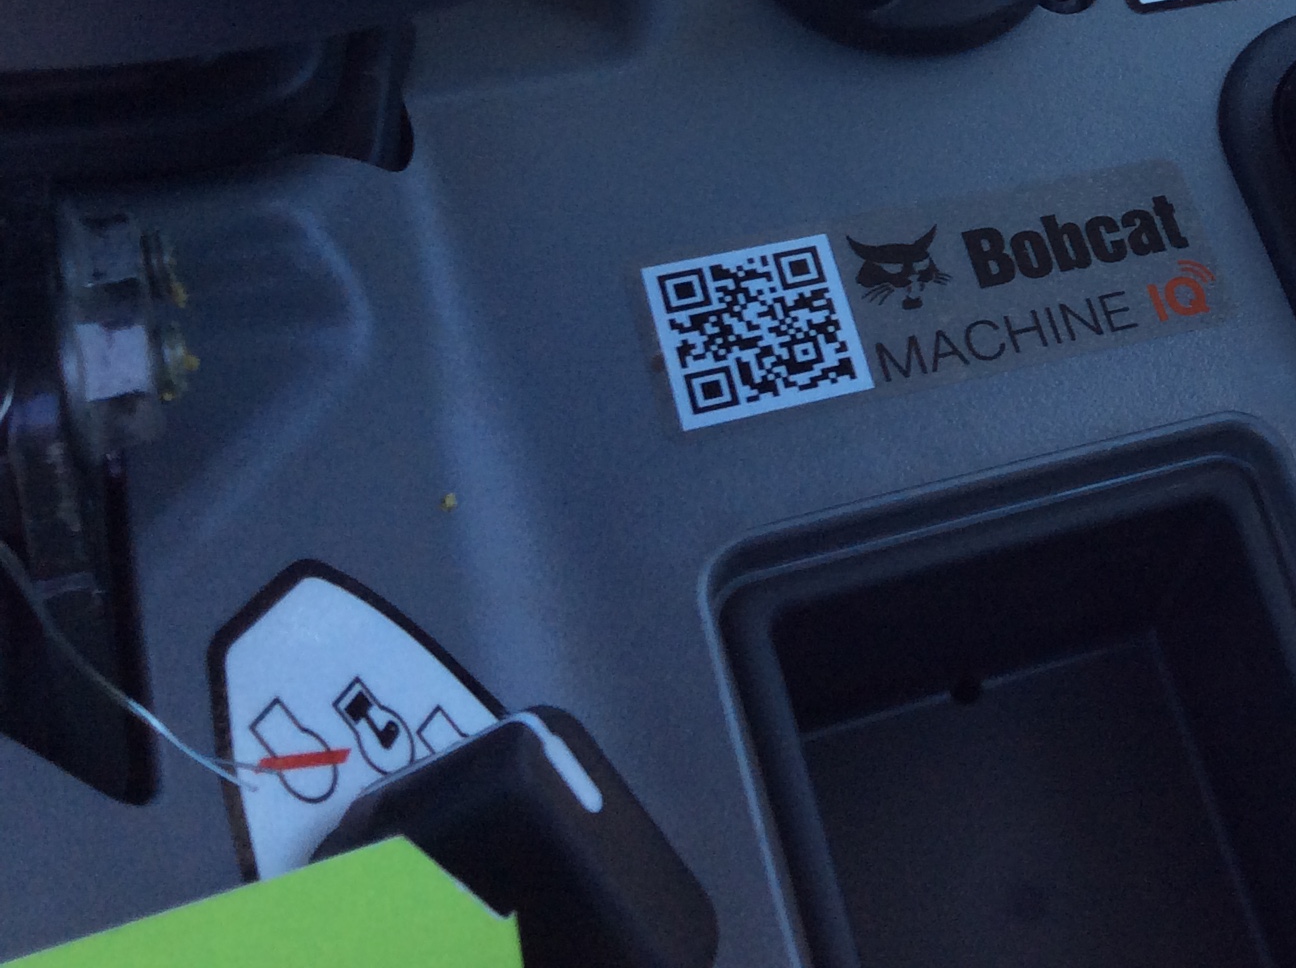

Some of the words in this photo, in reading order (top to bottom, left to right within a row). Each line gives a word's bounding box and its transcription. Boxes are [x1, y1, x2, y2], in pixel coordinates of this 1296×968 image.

[961, 195, 1190, 289] Bobcat
[875, 290, 1139, 383] MACHINE
[1146, 275, 1211, 322] IQ
